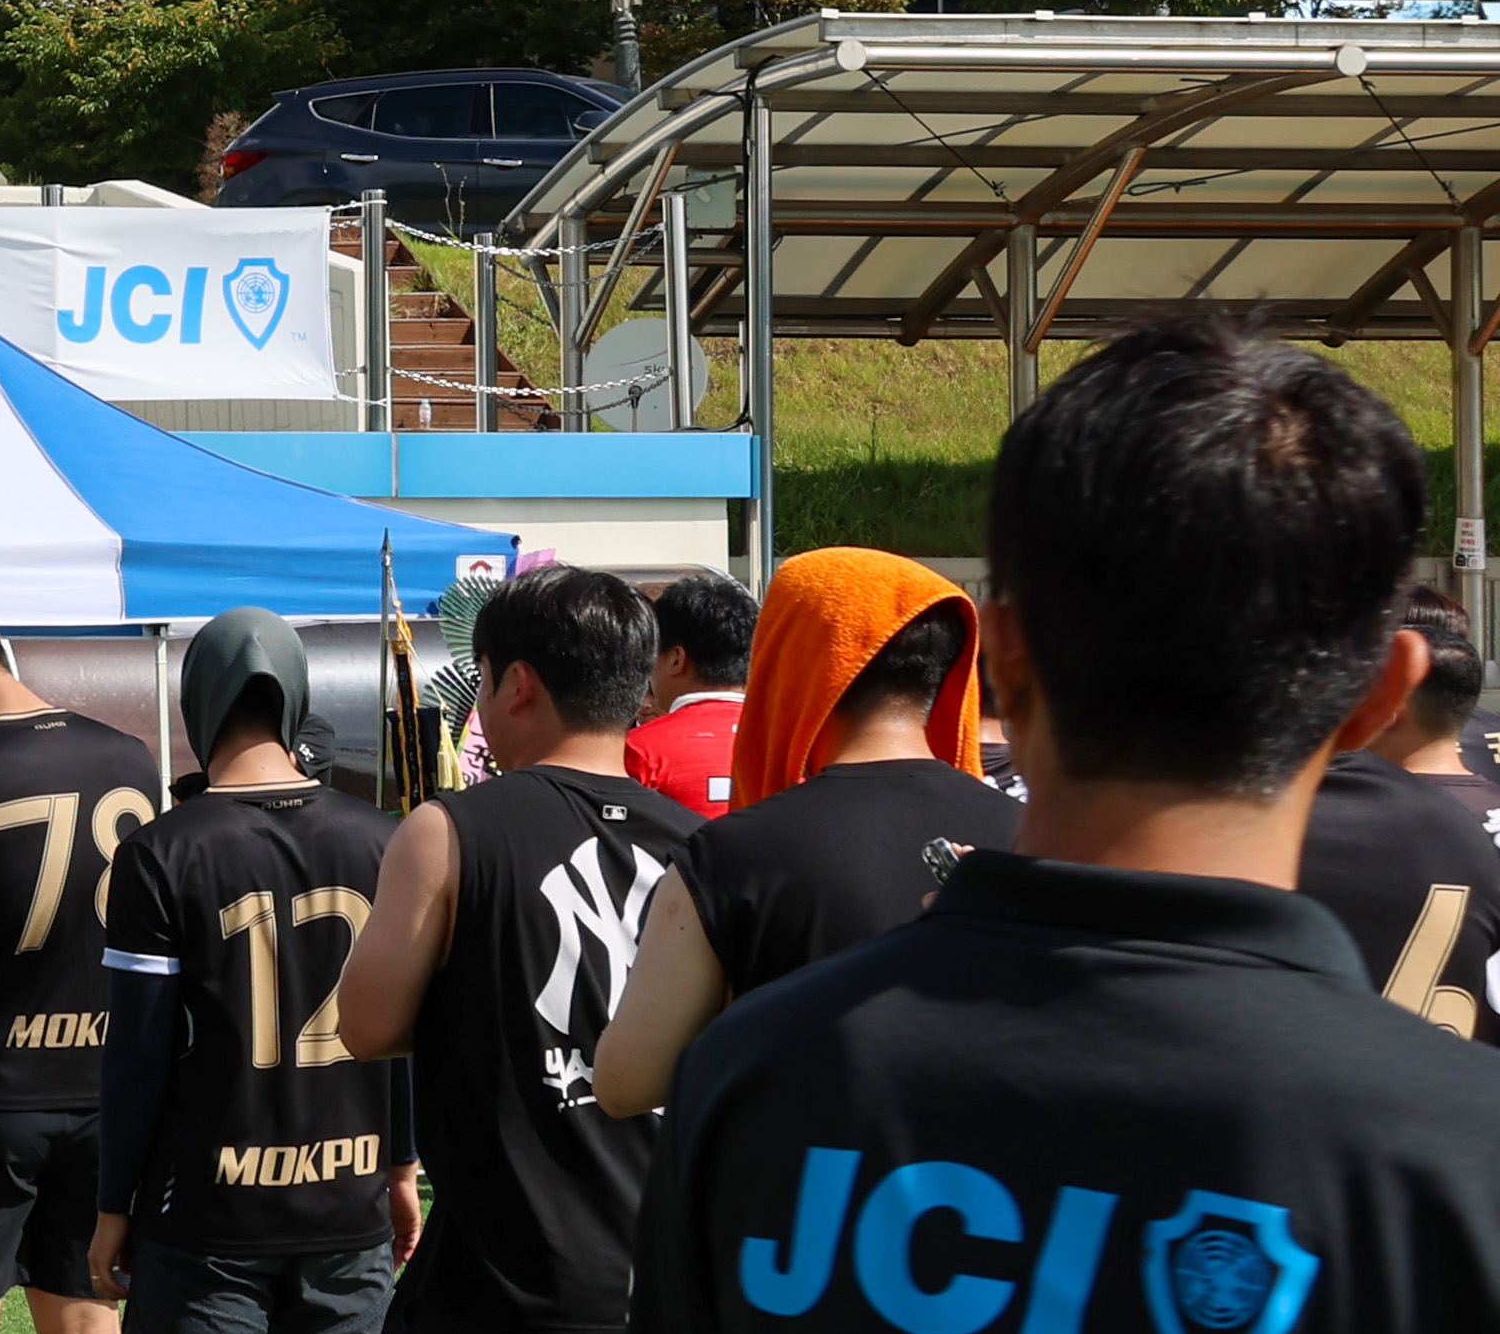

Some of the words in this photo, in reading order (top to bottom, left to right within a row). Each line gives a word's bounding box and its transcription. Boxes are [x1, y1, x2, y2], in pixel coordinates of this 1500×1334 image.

[57, 265, 209, 344] JCI
[218, 886, 377, 1069] 12
[5, 1011, 110, 1049] MOK
[214, 1134, 381, 1188] MOKPO
